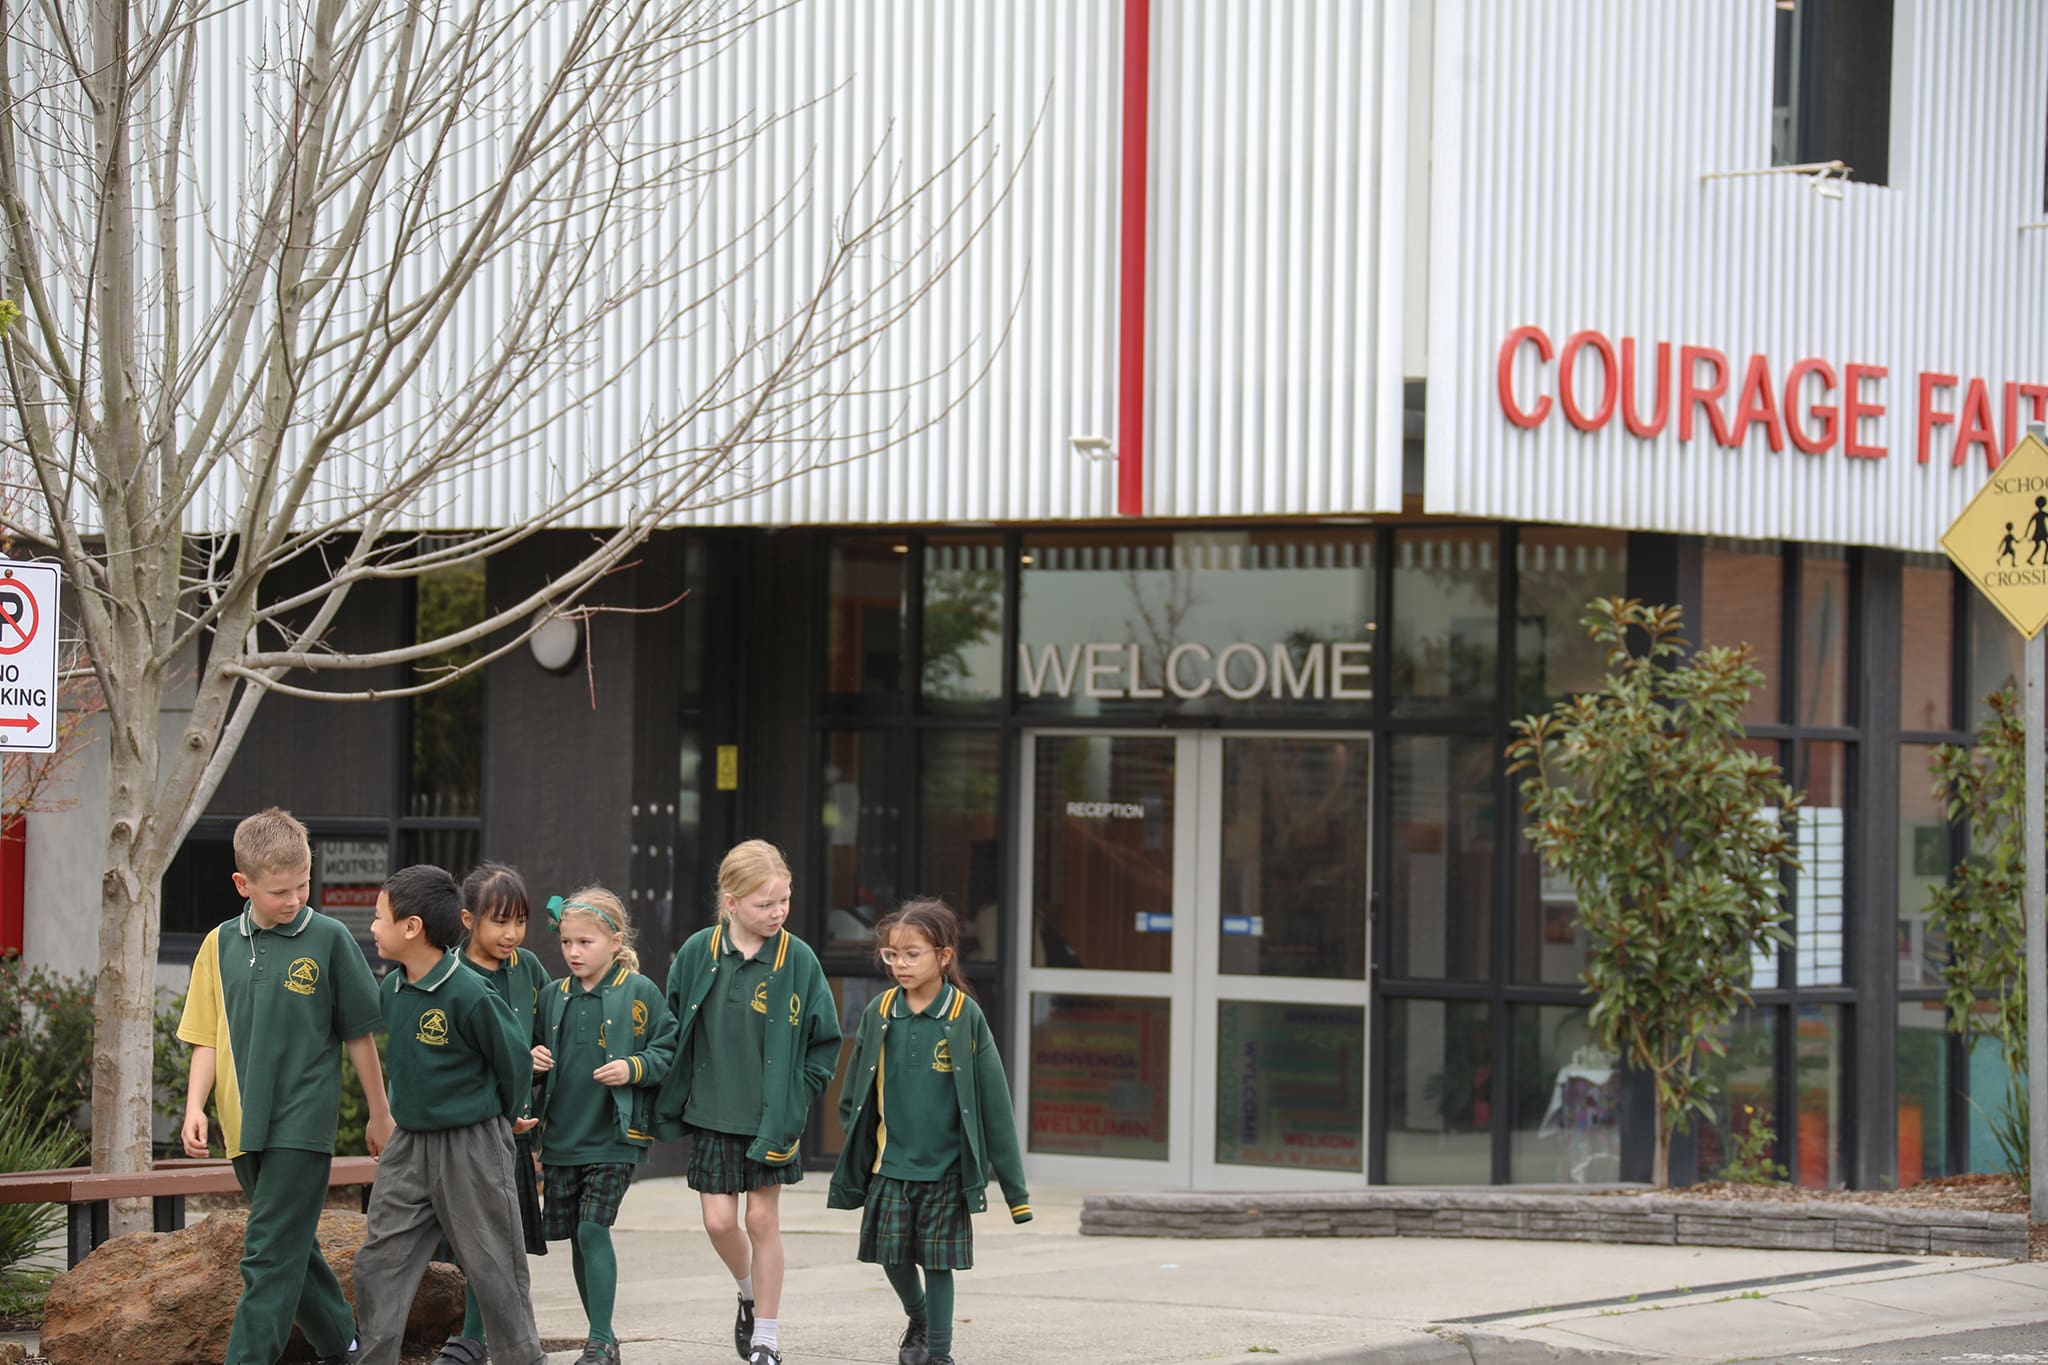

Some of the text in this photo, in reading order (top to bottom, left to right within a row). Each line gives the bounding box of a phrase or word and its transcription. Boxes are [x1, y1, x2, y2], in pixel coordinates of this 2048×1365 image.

[1498, 325, 1889, 459] COURAGE
[1994, 476, 2048, 494] SCHO
[1018, 642, 1373, 699] WELCOME
[1066, 802, 1145, 819] RECEPTION
